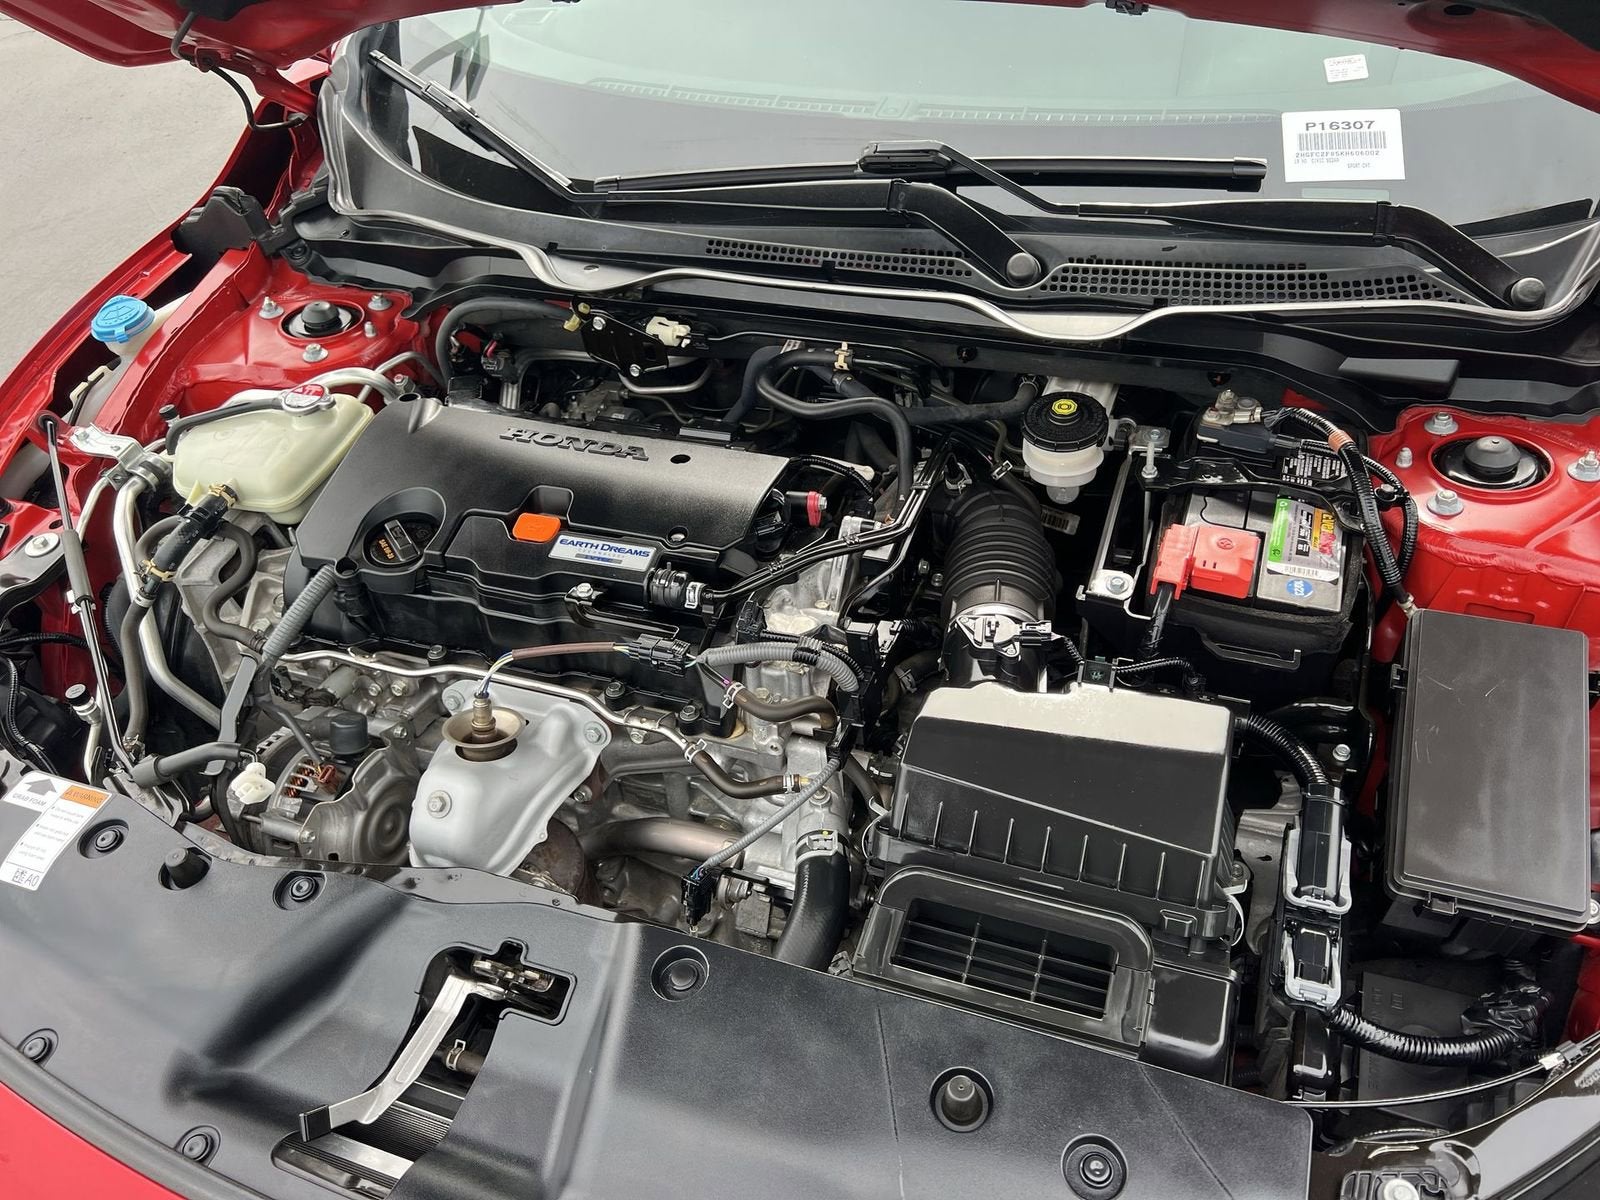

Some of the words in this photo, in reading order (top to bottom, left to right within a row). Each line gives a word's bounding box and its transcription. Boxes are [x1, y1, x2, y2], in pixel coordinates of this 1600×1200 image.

[1305, 120, 1375, 131] P16307
[499, 427, 649, 461] HONDA
[559, 538, 600, 550] EARTH
[600, 543, 651, 558] DREAMS
